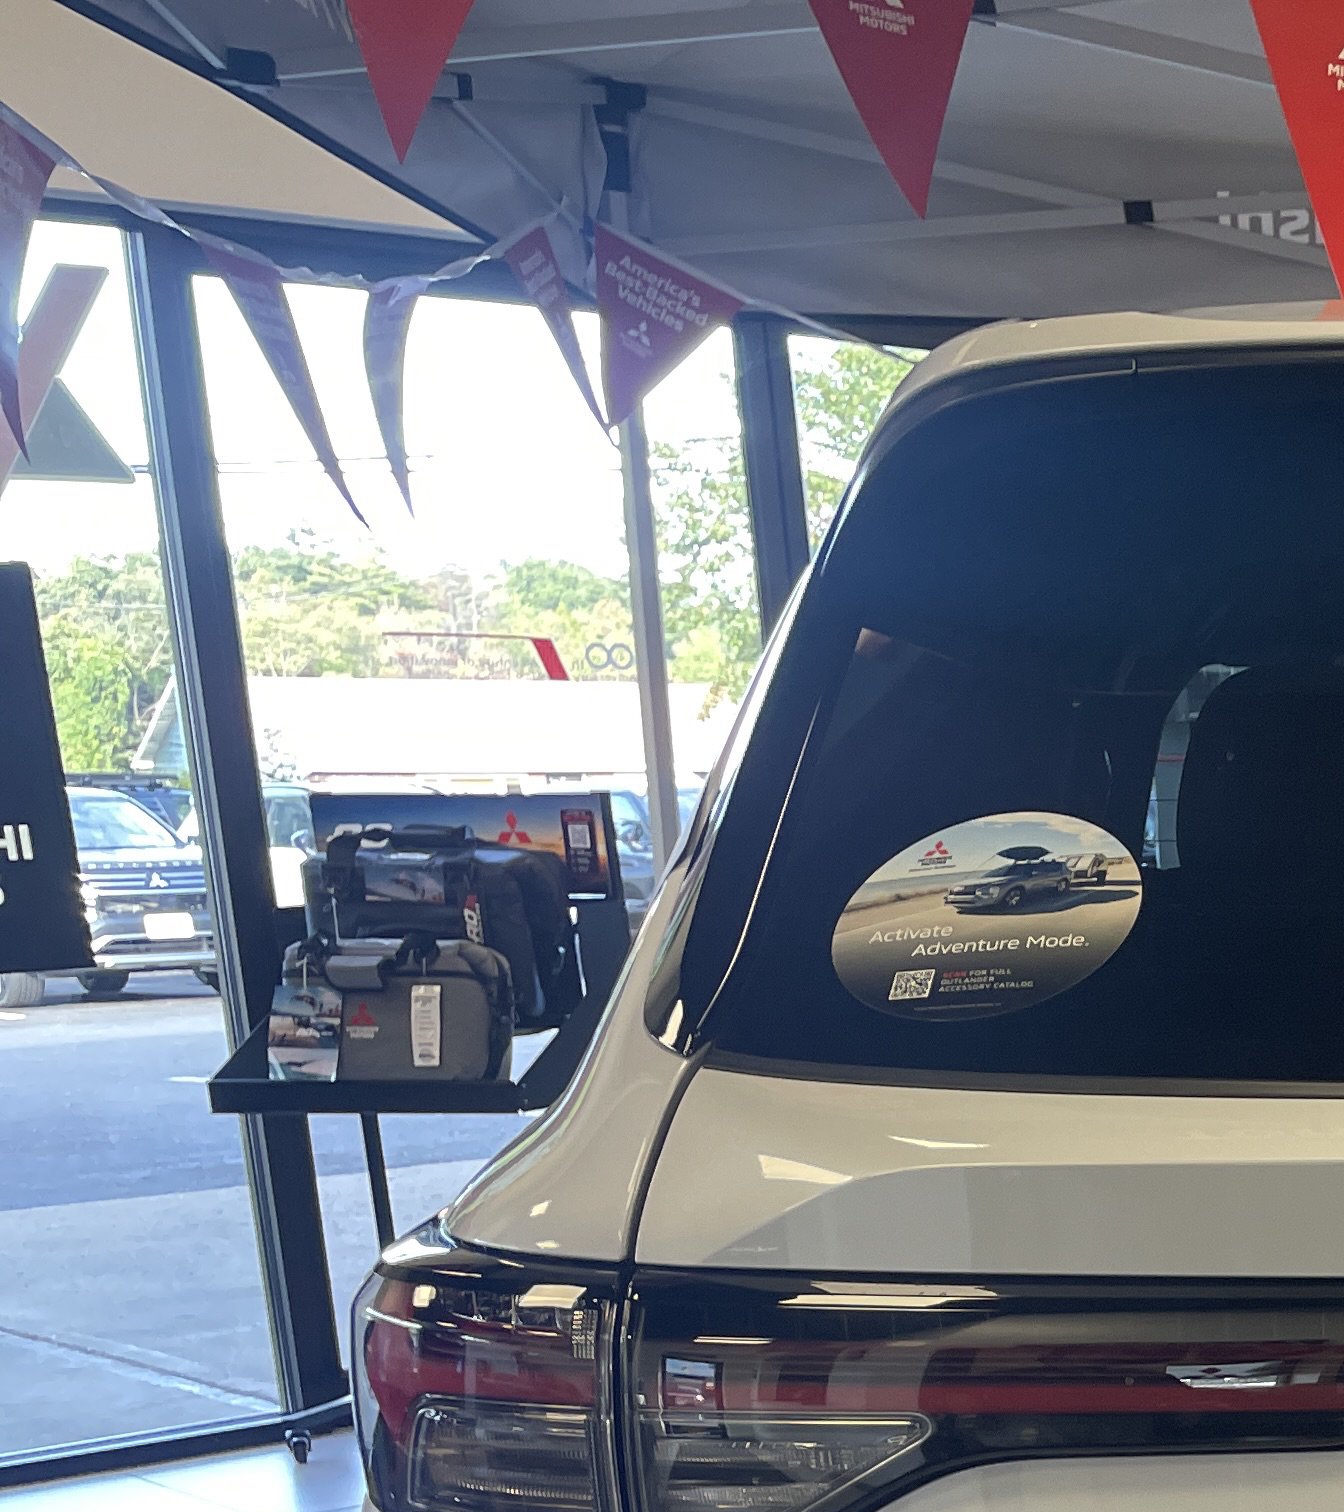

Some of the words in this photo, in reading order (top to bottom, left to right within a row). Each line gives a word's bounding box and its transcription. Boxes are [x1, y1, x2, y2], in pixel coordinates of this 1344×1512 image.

[604, 261, 709, 326] Best-Backed
[619, 255, 700, 307] America's
[618, 284, 684, 333] Vehicles
[868, 925, 954, 944] Activate
[911, 936, 1020, 958] Adventure
[1025, 933, 1091, 949] Mode.
[938, 983, 991, 993] ACCESSORY
[993, 980, 1034, 990] CATALOG
[941, 976, 995, 985] OUTLANDER
